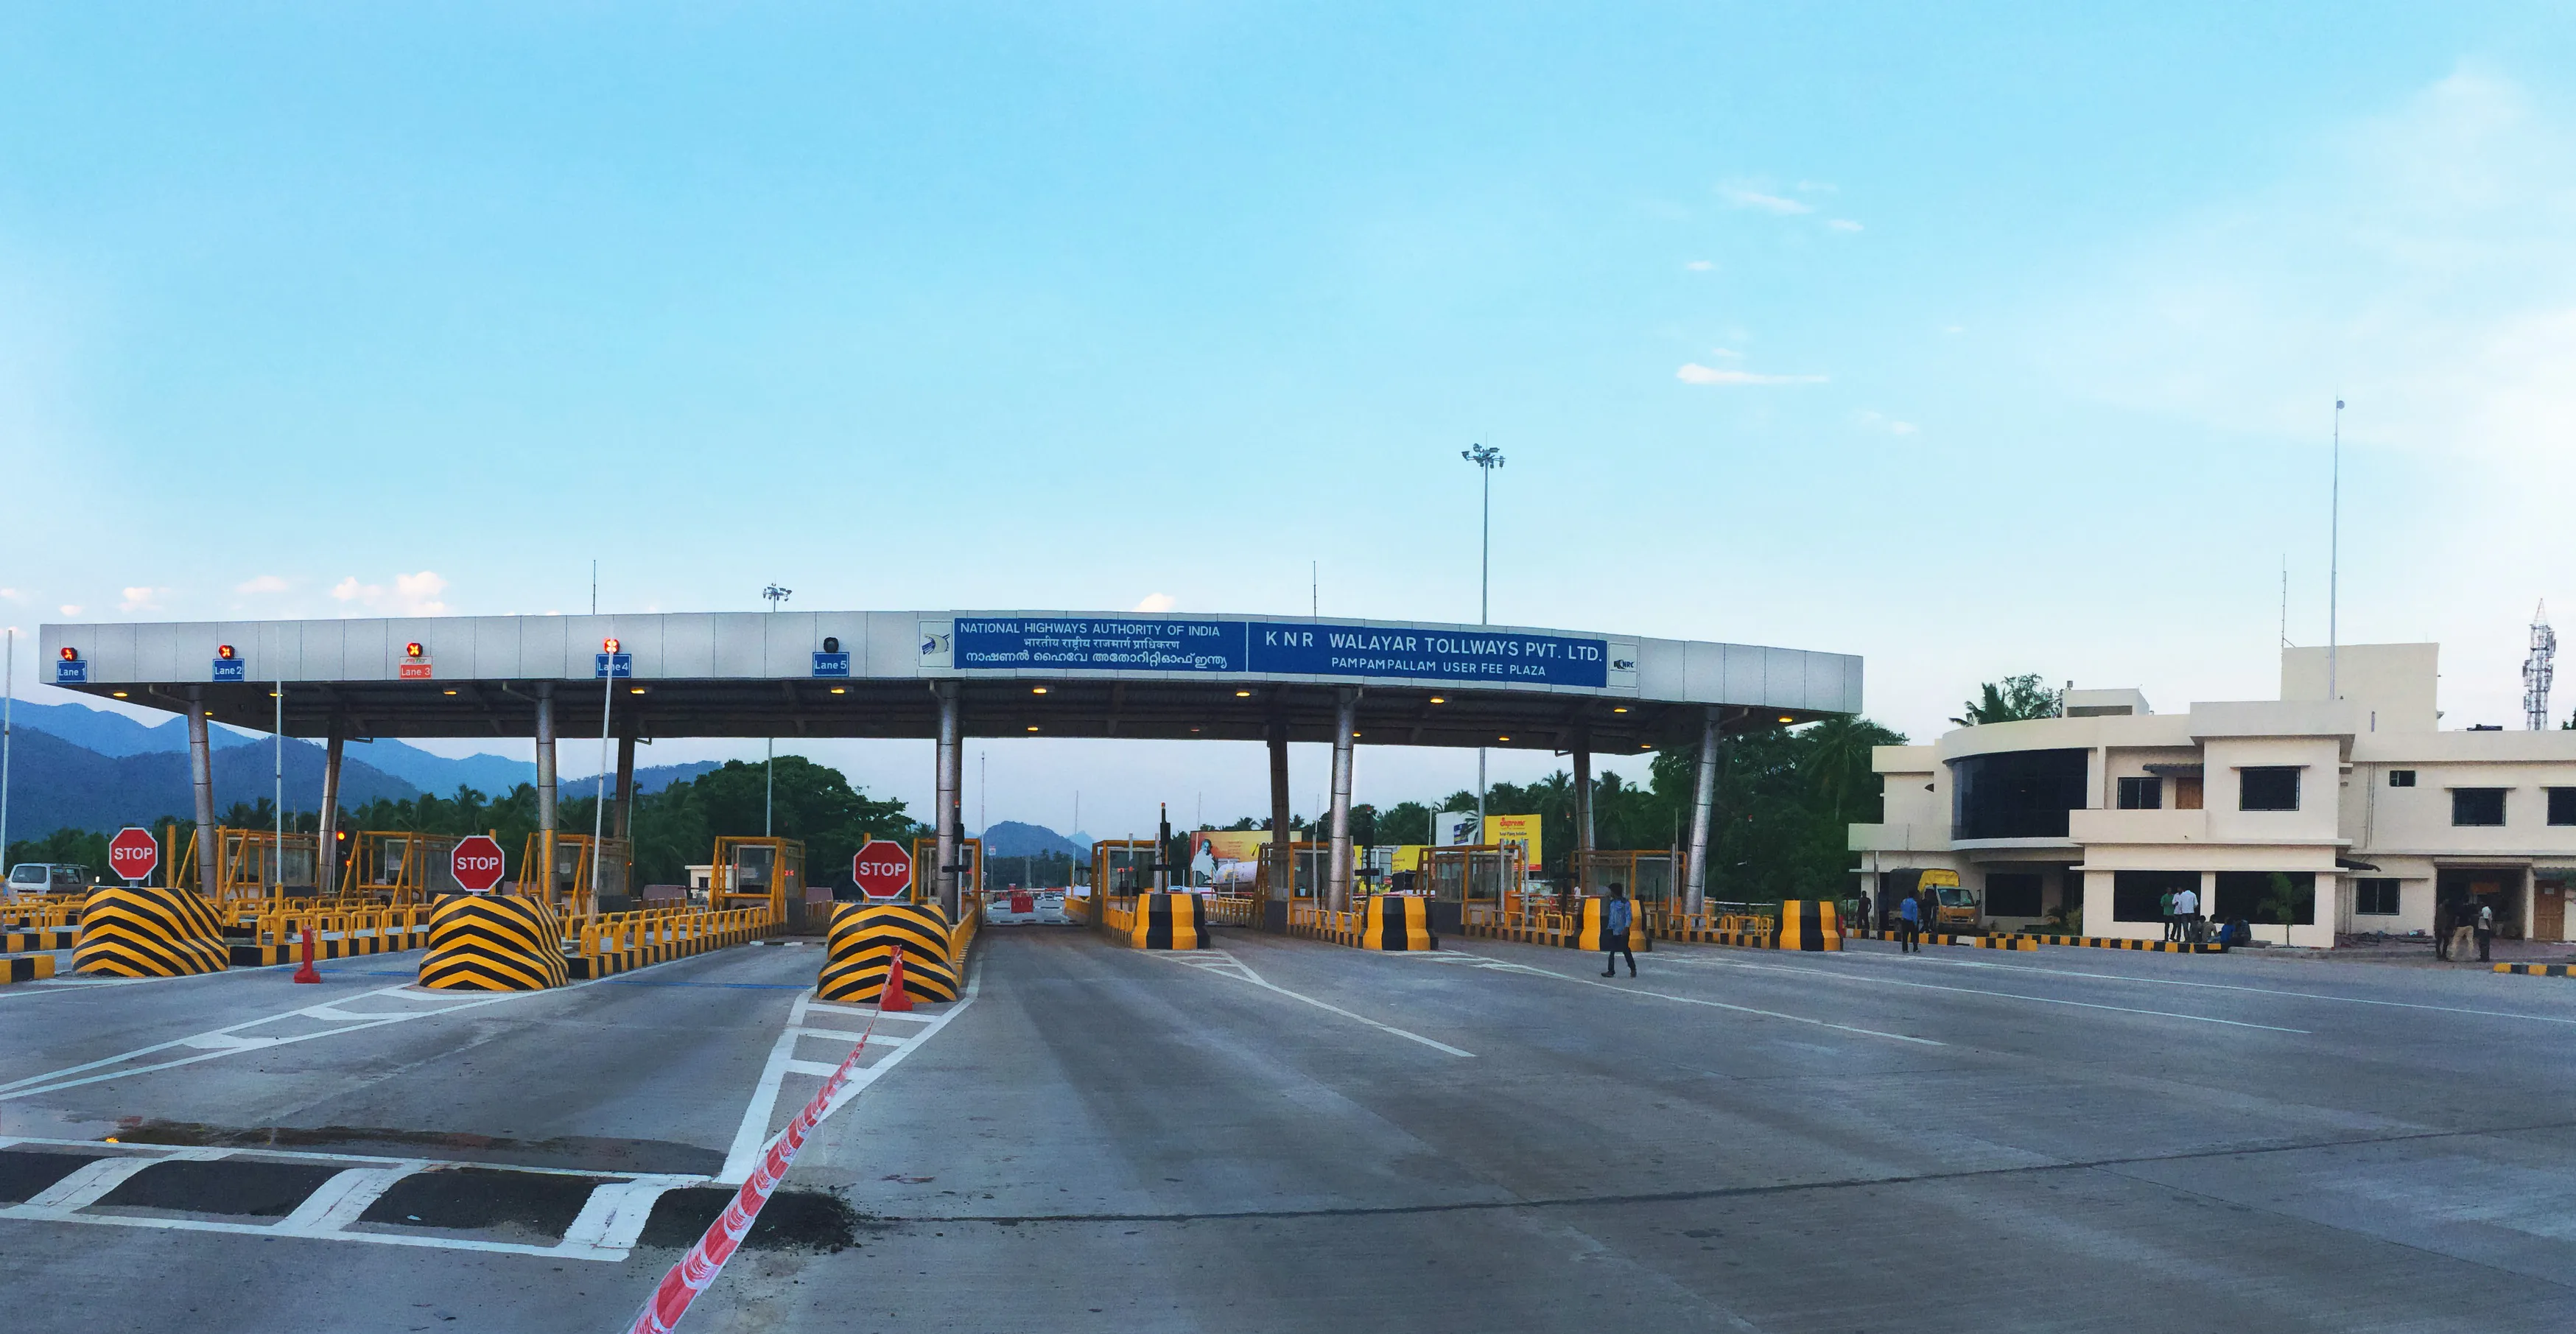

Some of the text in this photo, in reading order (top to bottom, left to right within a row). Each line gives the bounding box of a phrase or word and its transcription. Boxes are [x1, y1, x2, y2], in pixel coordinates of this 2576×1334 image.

[961, 622, 1220, 636] NATIONAL HIGHWAYS AUTHORITY OF INDIA
[1024, 635, 1180, 650] भारतीय राष्ट्रीय राजमार्ग प्राधिकरण
[1329, 633, 1417, 652] WALAYAR
[1425, 637, 1518, 656] TOLLWAYS
[1526, 642, 1561, 659] PVT.
[1568, 645, 1602, 661] LTD.
[966, 649, 1029, 661] നാഷണൽ
[1033, 652, 1088, 662] ഹൈവേ
[59, 667, 85, 676] Lane 1
[215, 666, 242, 675] Lane 2
[401, 667, 431, 675] Lane 3
[622, 662, 629, 671] 4
[815, 660, 847, 670] Lane 5
[1332, 657, 1546, 676] PAMPAMPALLAM USER FEE PLAZA
[114, 847, 153, 860] STOP
[457, 857, 499, 870] STOP
[860, 861, 907, 877] STOP
